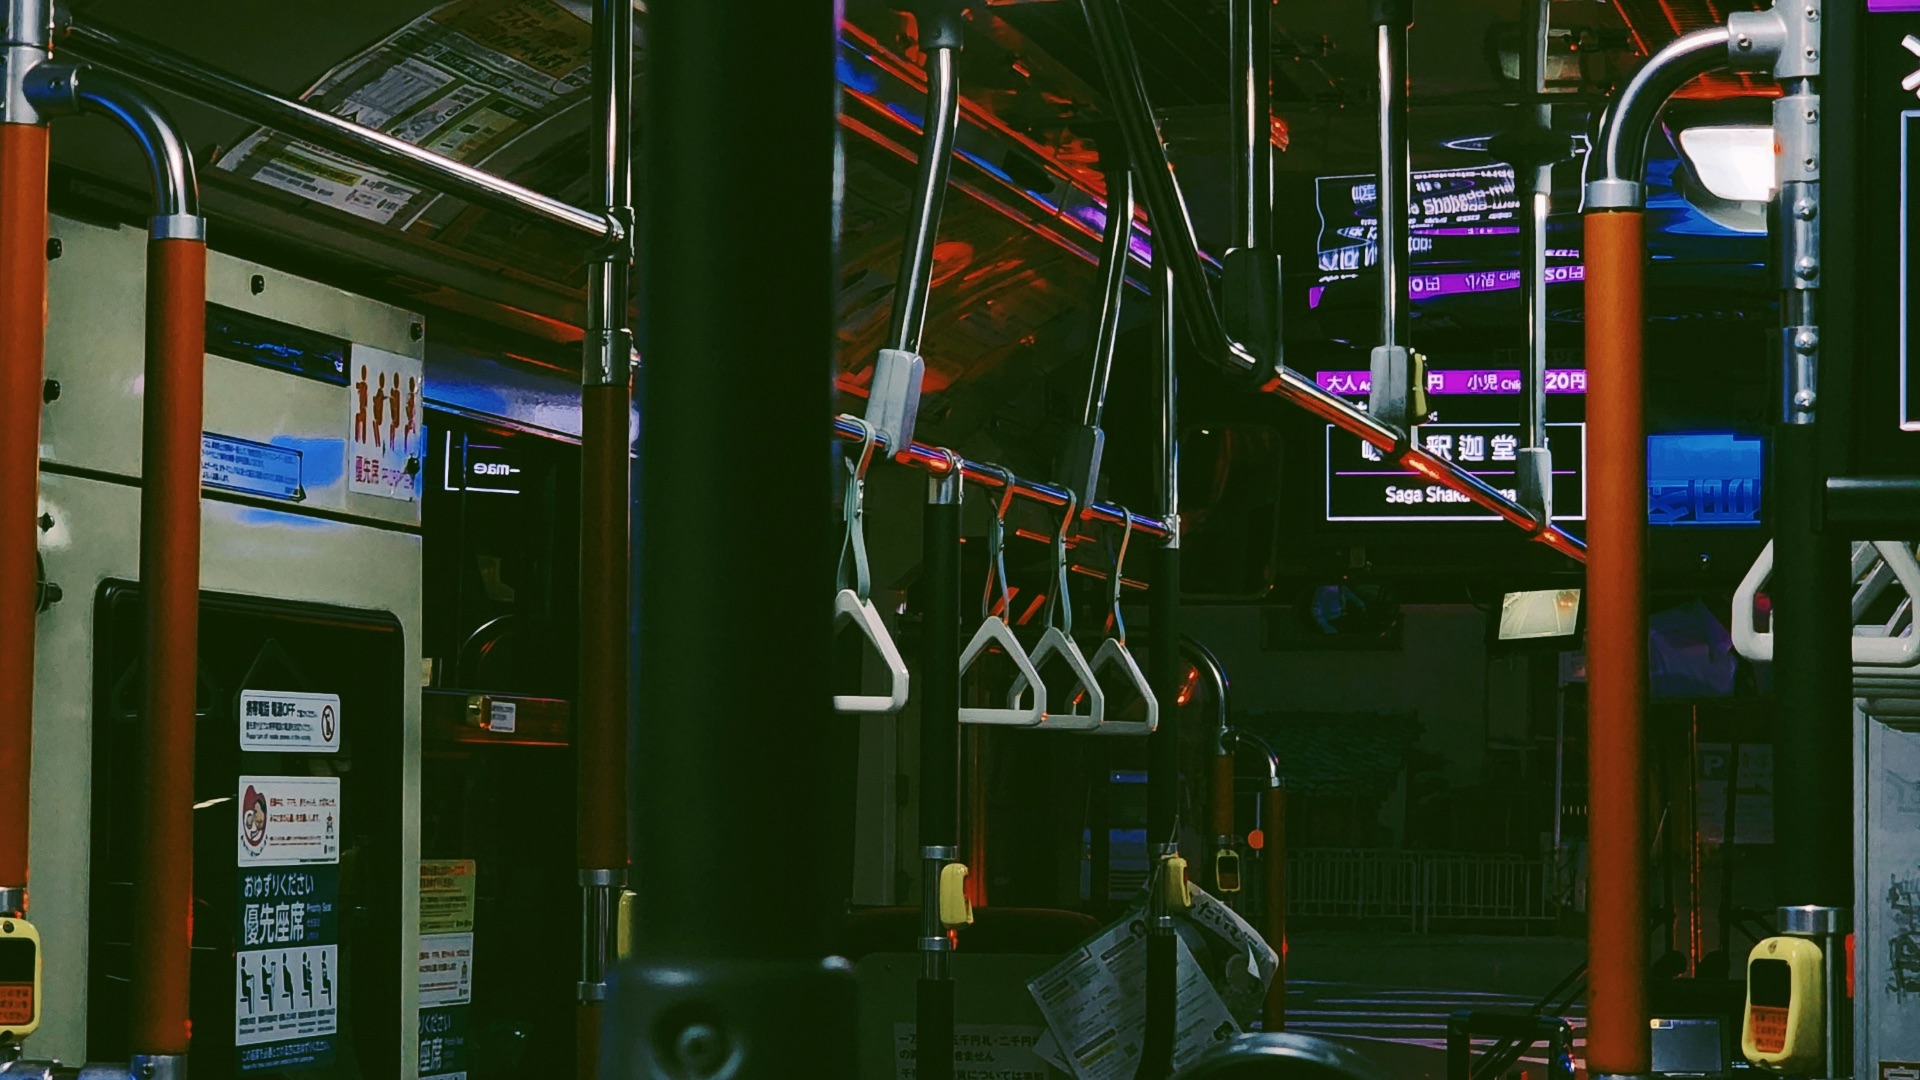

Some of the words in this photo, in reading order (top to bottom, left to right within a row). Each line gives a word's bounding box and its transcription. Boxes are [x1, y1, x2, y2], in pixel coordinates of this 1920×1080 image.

[1326, 374, 1357, 392] 大人
[1467, 374, 1498, 391] 小児
[1385, 486, 1422, 504] Saga
[1704, 755, 1723, 776] P
[244, 873, 314, 897] おゆずりください
[243, 901, 305, 945] 優先座席
